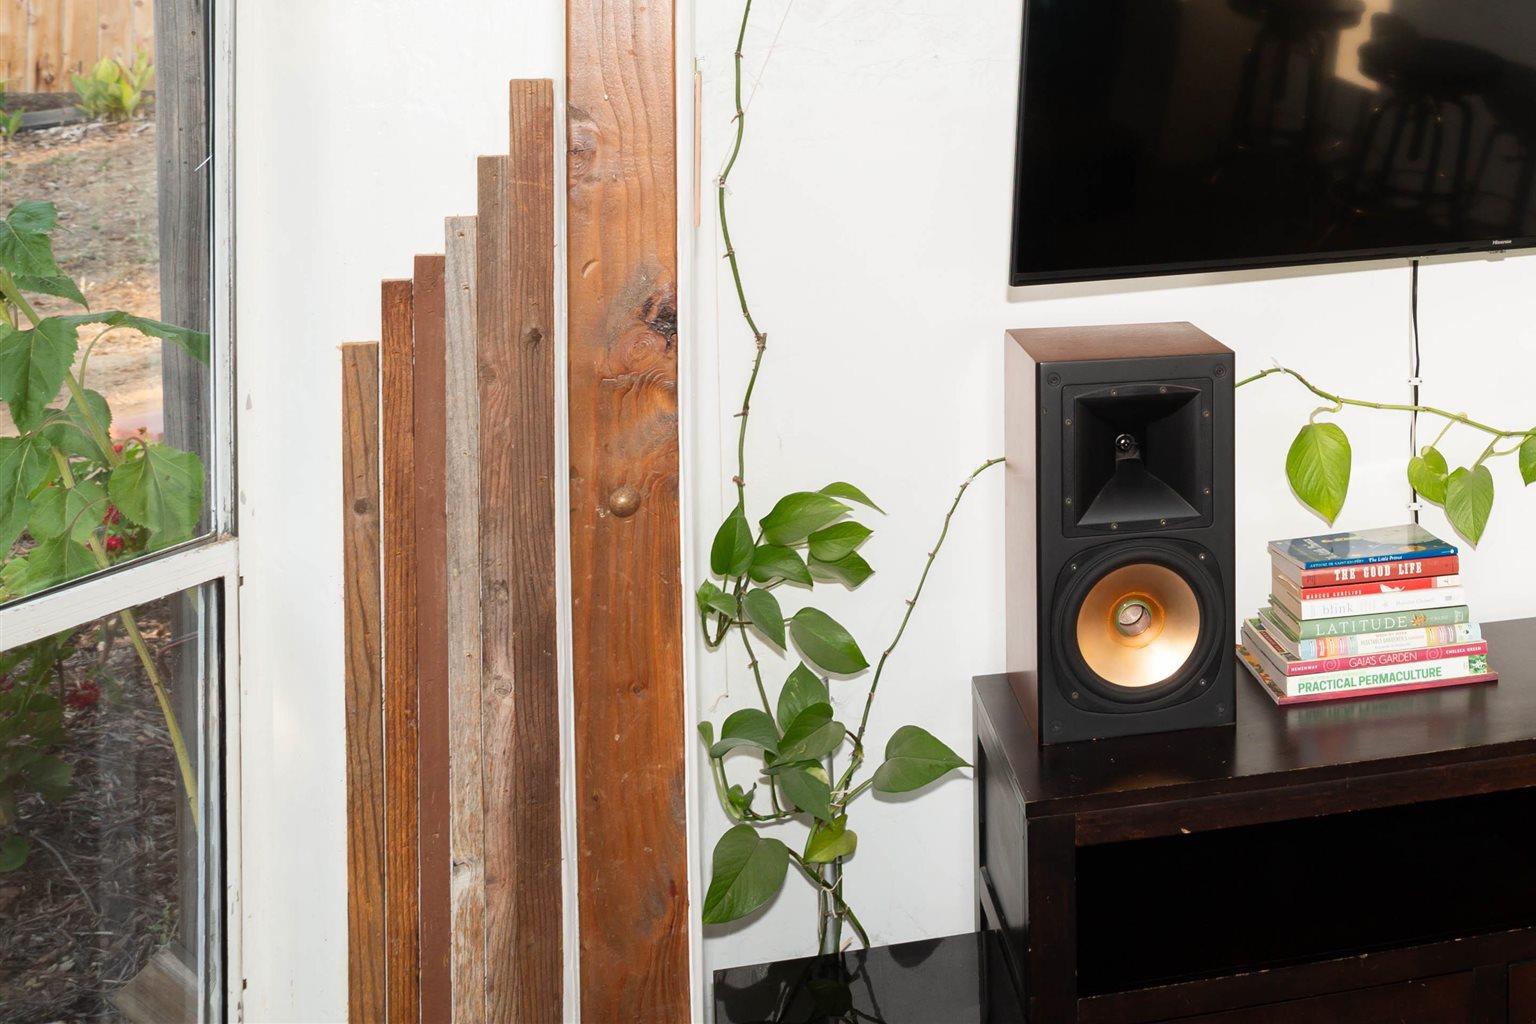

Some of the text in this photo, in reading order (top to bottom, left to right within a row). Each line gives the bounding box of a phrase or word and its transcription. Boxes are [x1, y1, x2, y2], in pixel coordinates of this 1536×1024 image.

[1334, 561, 1422, 581] THE GOOD LIFE
[1322, 602, 1353, 614] blink
[1316, 616, 1408, 636] LATITUDE
[1348, 651, 1418, 668] GAIA'S GARDEN
[1298, 666, 1442, 694] PRACTICAL PERMACULTURE
